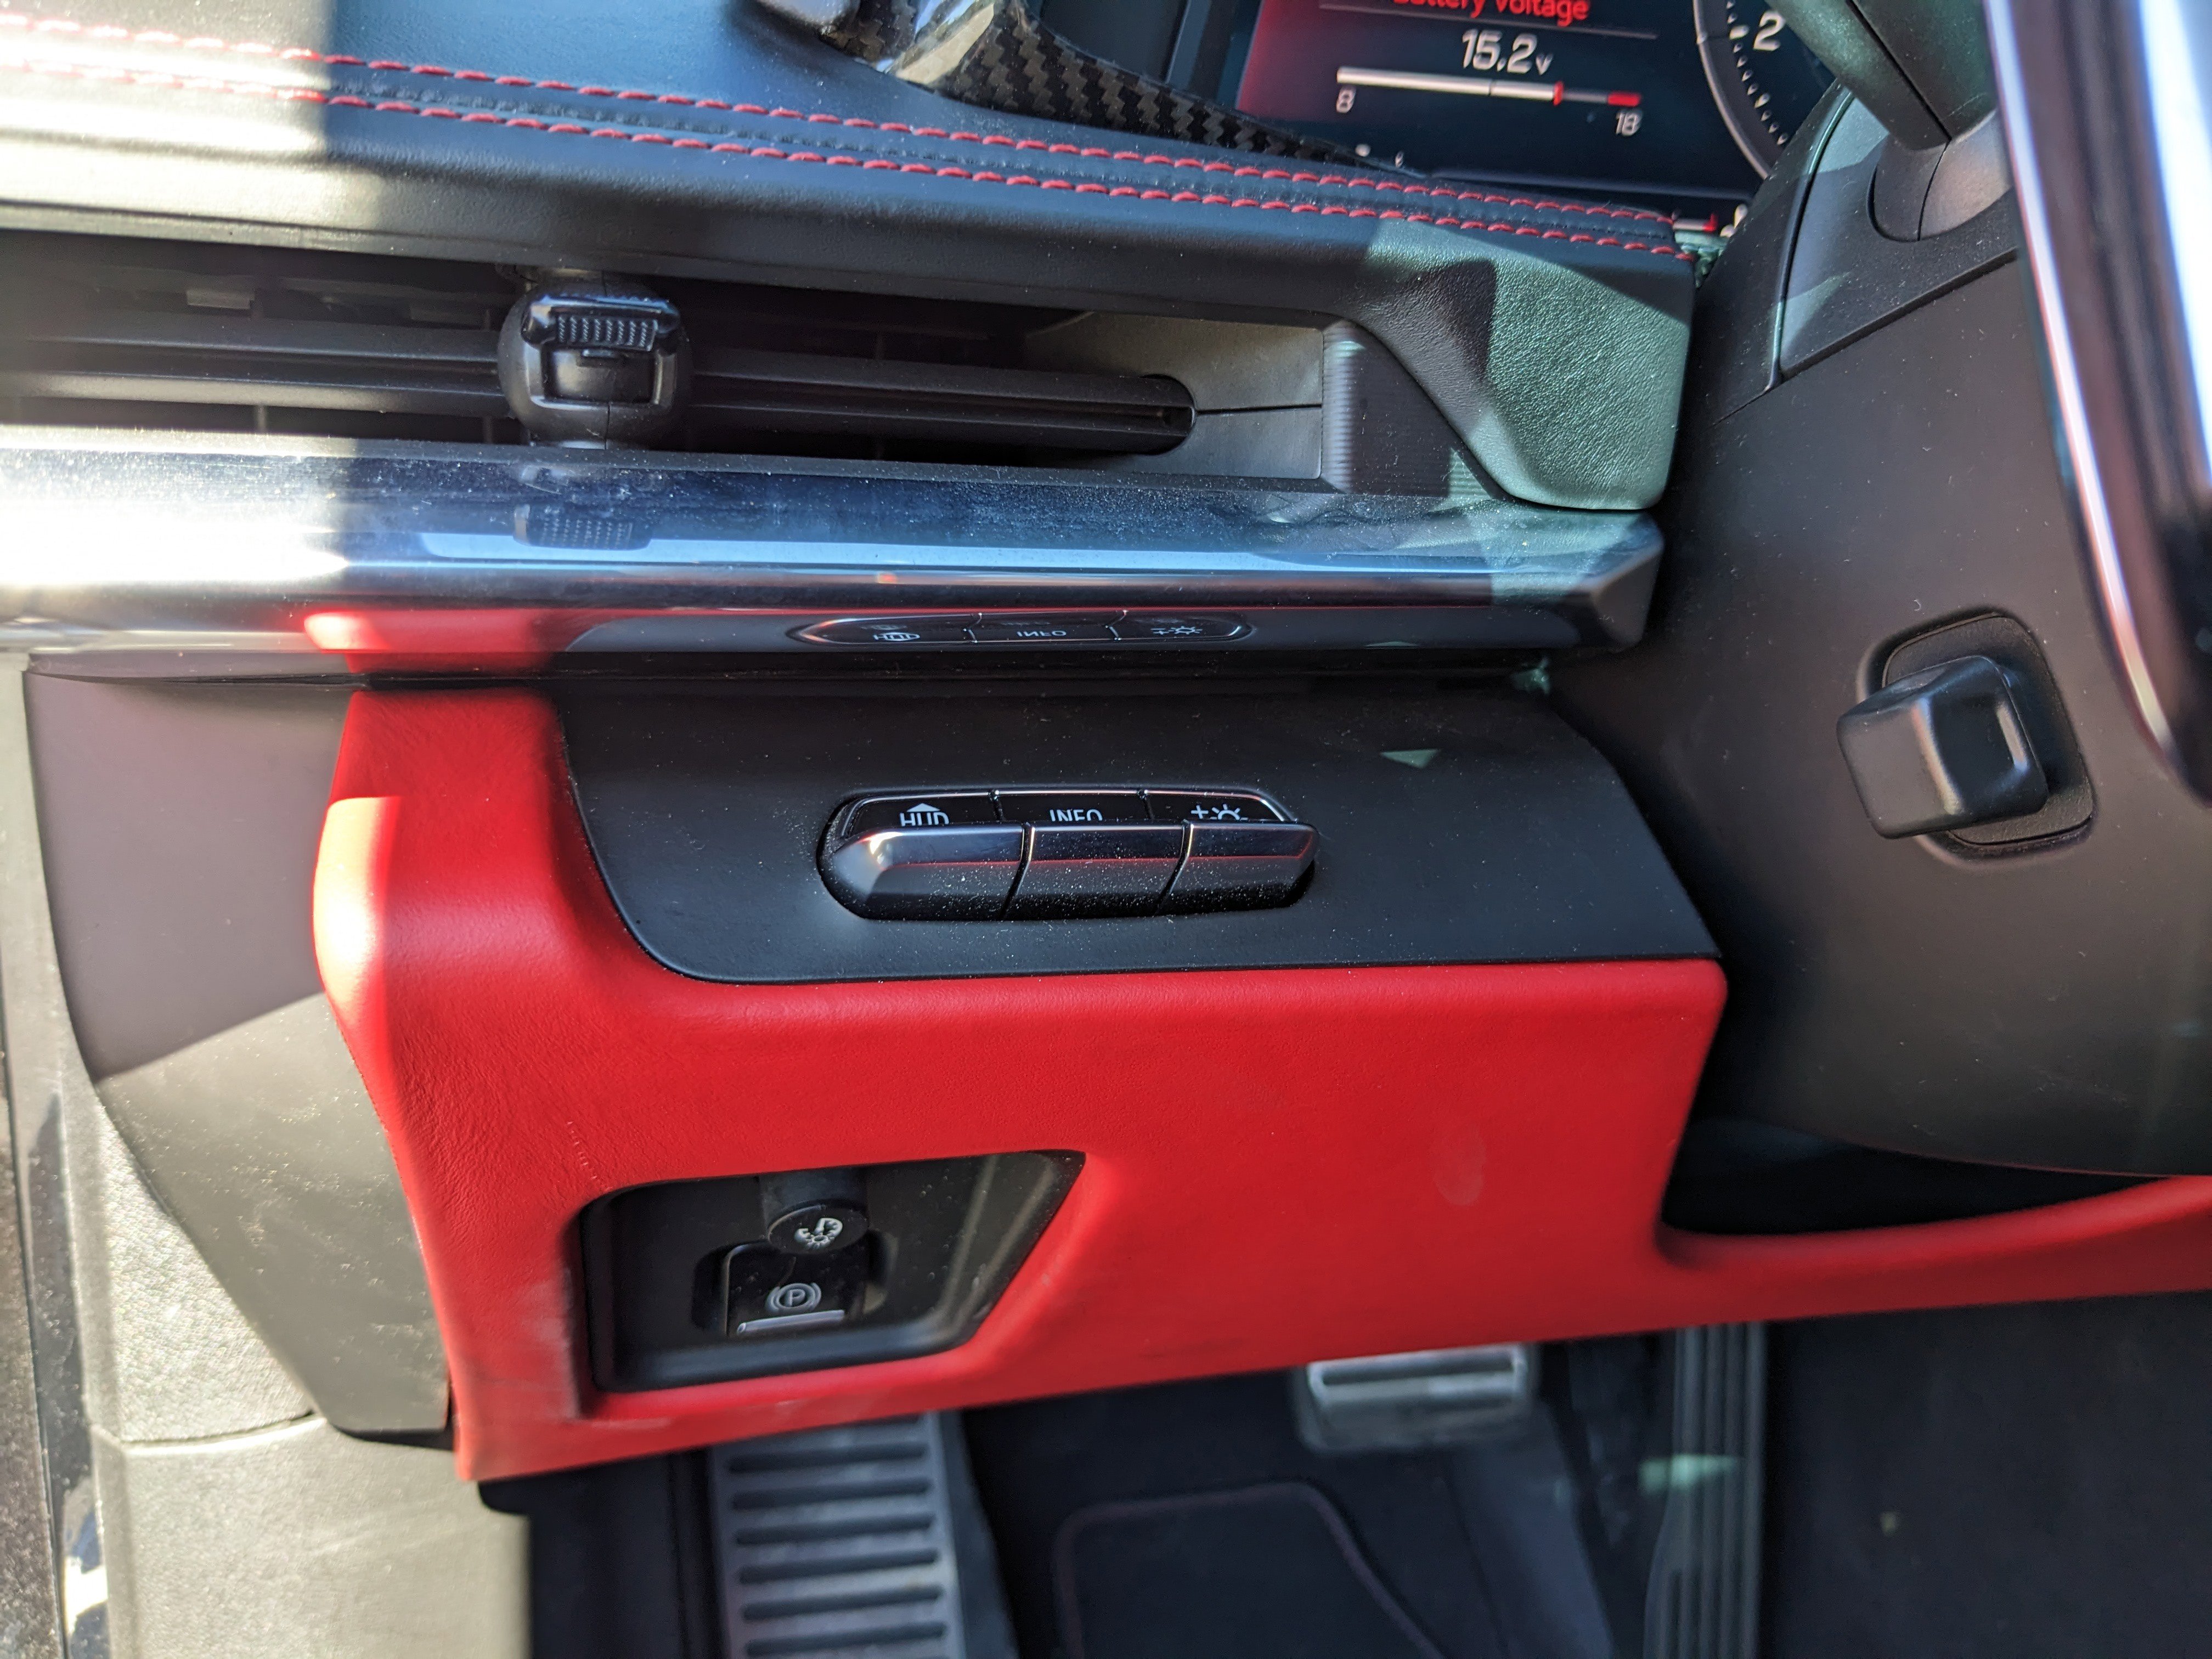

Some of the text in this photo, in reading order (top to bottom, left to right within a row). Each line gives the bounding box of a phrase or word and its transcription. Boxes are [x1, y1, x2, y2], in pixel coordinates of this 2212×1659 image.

[1753, 10, 1785, 51] 2
[1336, 85, 1357, 114] 8
[1615, 109, 1643, 137] 18
[900, 812, 950, 827] HUD
[1049, 809, 1103, 822] INFO
